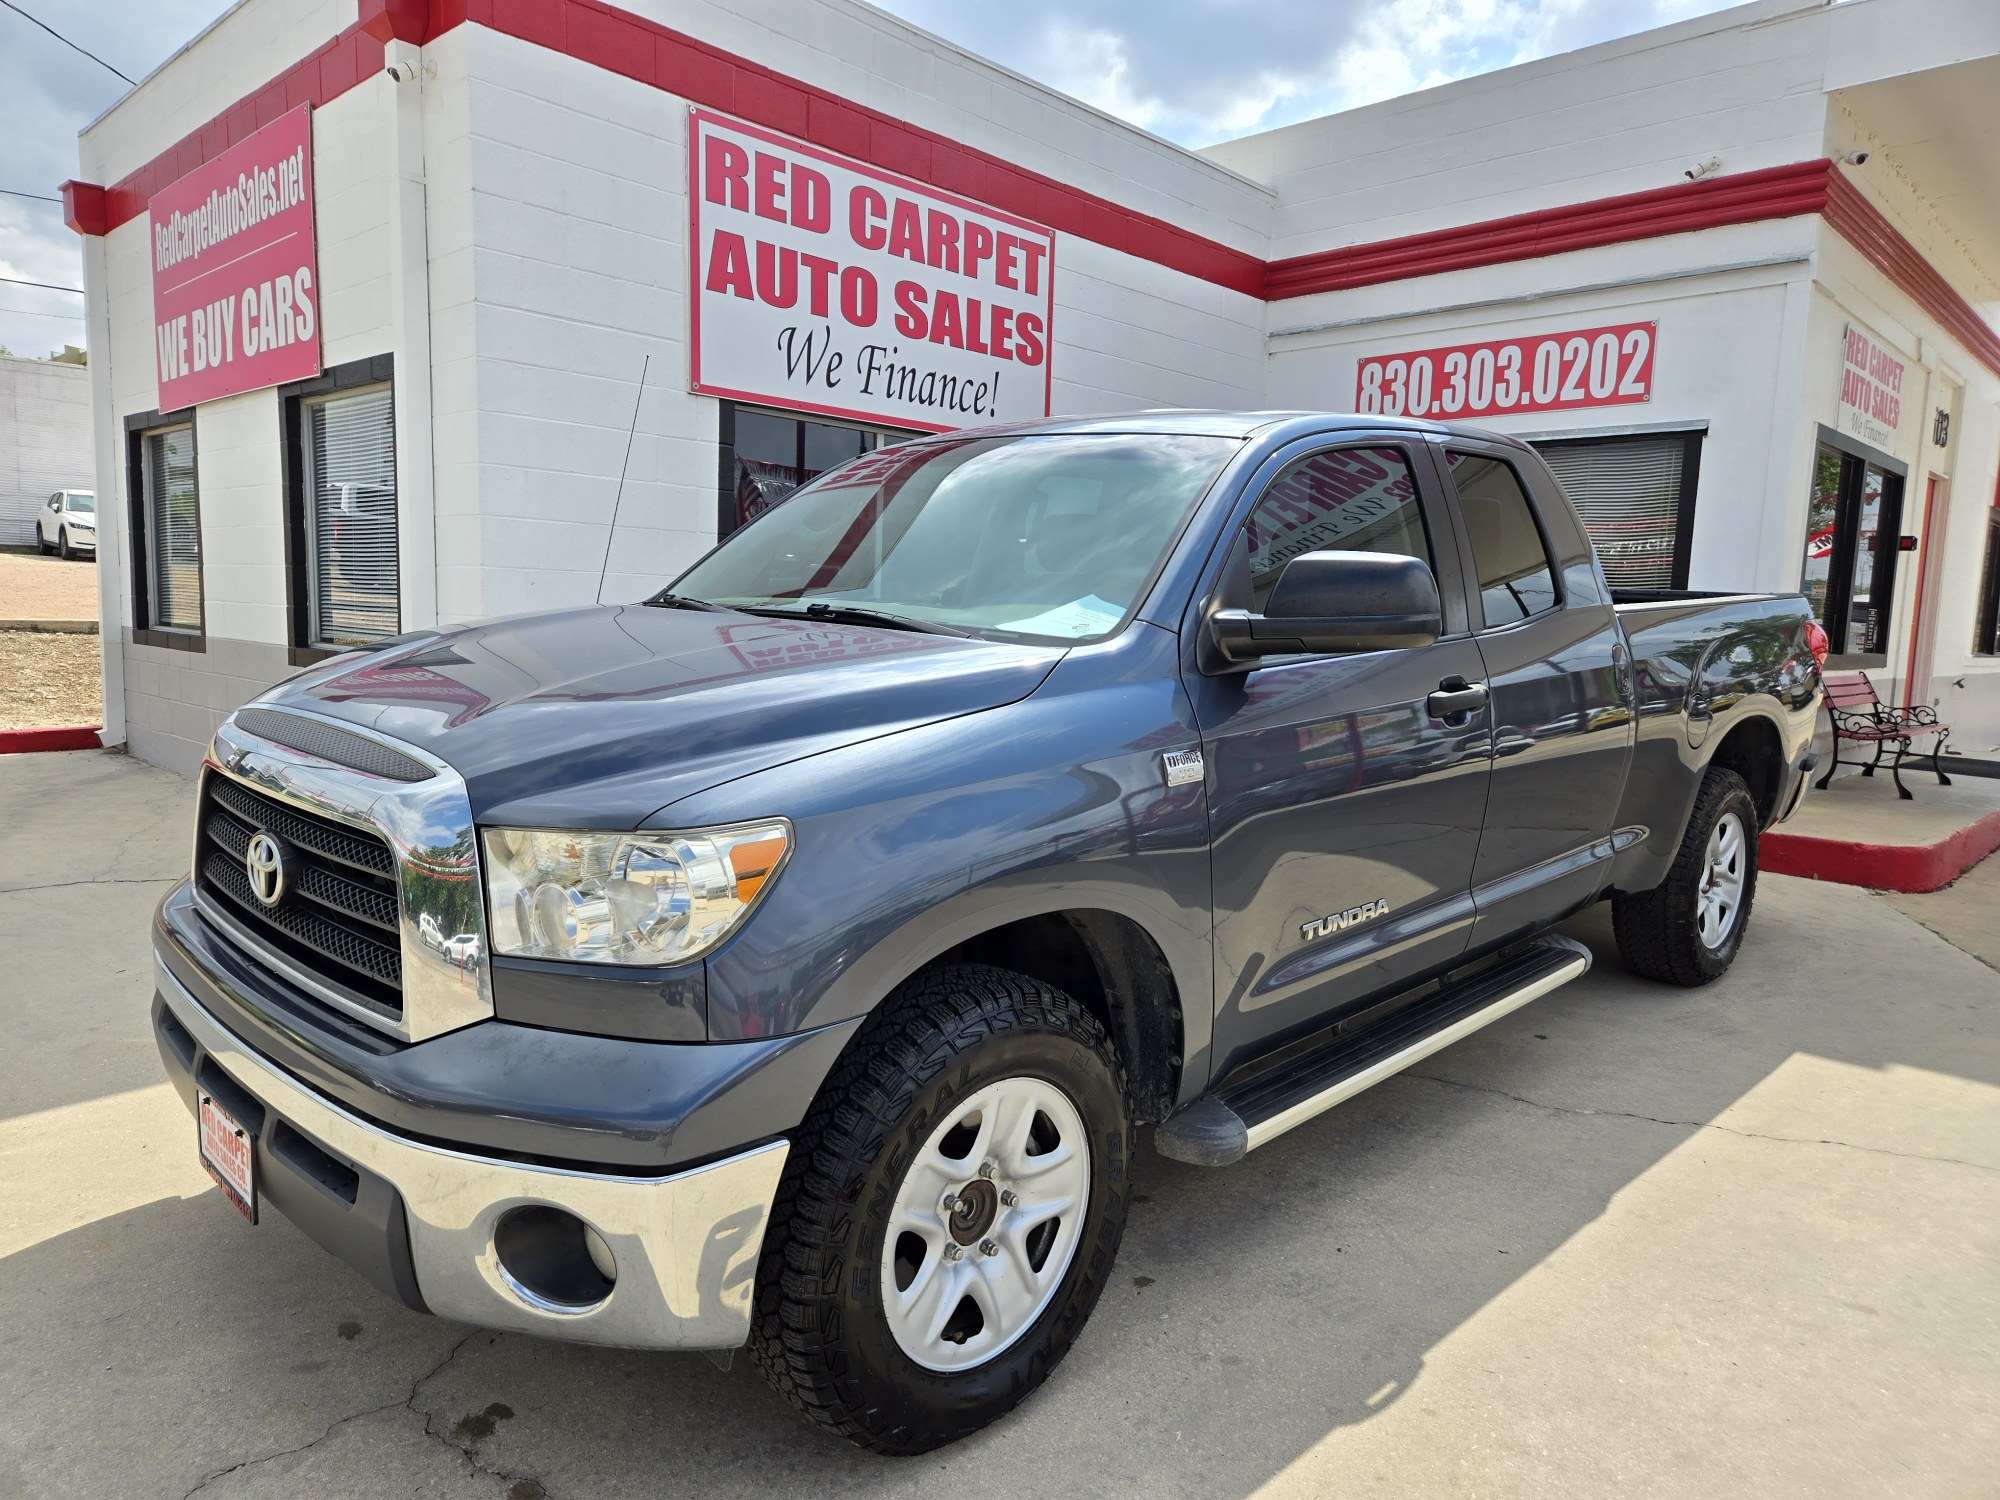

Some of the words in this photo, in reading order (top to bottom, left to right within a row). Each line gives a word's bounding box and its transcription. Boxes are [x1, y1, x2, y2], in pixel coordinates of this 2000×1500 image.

[155, 144, 305, 273] RedCarpetAutoSales.net
[705, 134, 832, 234] RED
[848, 184, 1047, 297] CARPET
[157, 316, 189, 383] WE
[192, 294, 236, 372] BUY
[241, 265, 314, 358] CARS
[705, 228, 879, 328] AUTO
[893, 280, 1044, 367] SALES
[776, 324, 843, 389] We
[856, 343, 1000, 418] Finance!
[1359, 328, 1652, 417] 830.303.0202
[1840, 367, 1872, 415] AUTO
[1871, 385, 1900, 430] SALES
[1845, 327, 1869, 372] RED
[1868, 343, 1904, 394] CARPET
[1851, 412, 1863, 435] We
[1300, 898, 1390, 941] TUNDRA
[216, 1119, 251, 1170] CARPET
